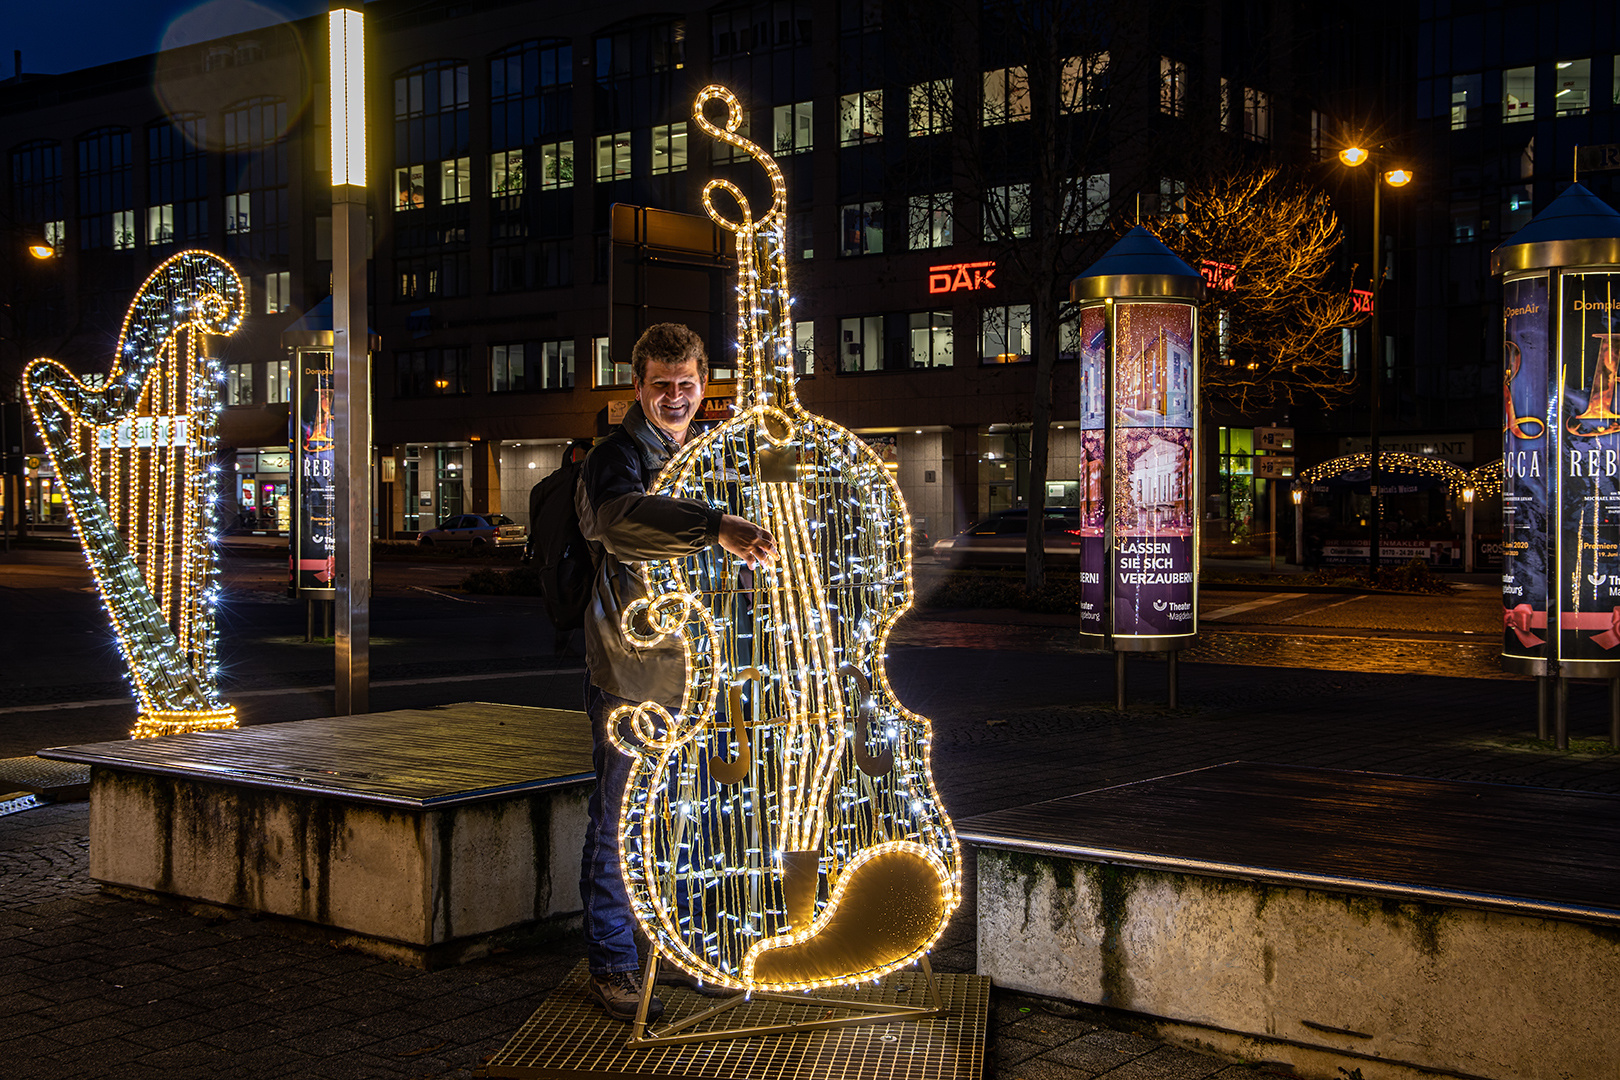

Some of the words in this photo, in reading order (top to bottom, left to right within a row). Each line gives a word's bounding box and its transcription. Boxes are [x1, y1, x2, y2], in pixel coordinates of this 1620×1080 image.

[929, 260, 997, 294] DAK
[1364, 441, 1466, 455] RSTAURANT
[303, 459, 331, 477] REB
[1569, 450, 1617, 477] REB
[1120, 542, 1171, 554] LASSEN
[1120, 557, 1141, 569] SIE
[1143, 557, 1174, 569] SICH
